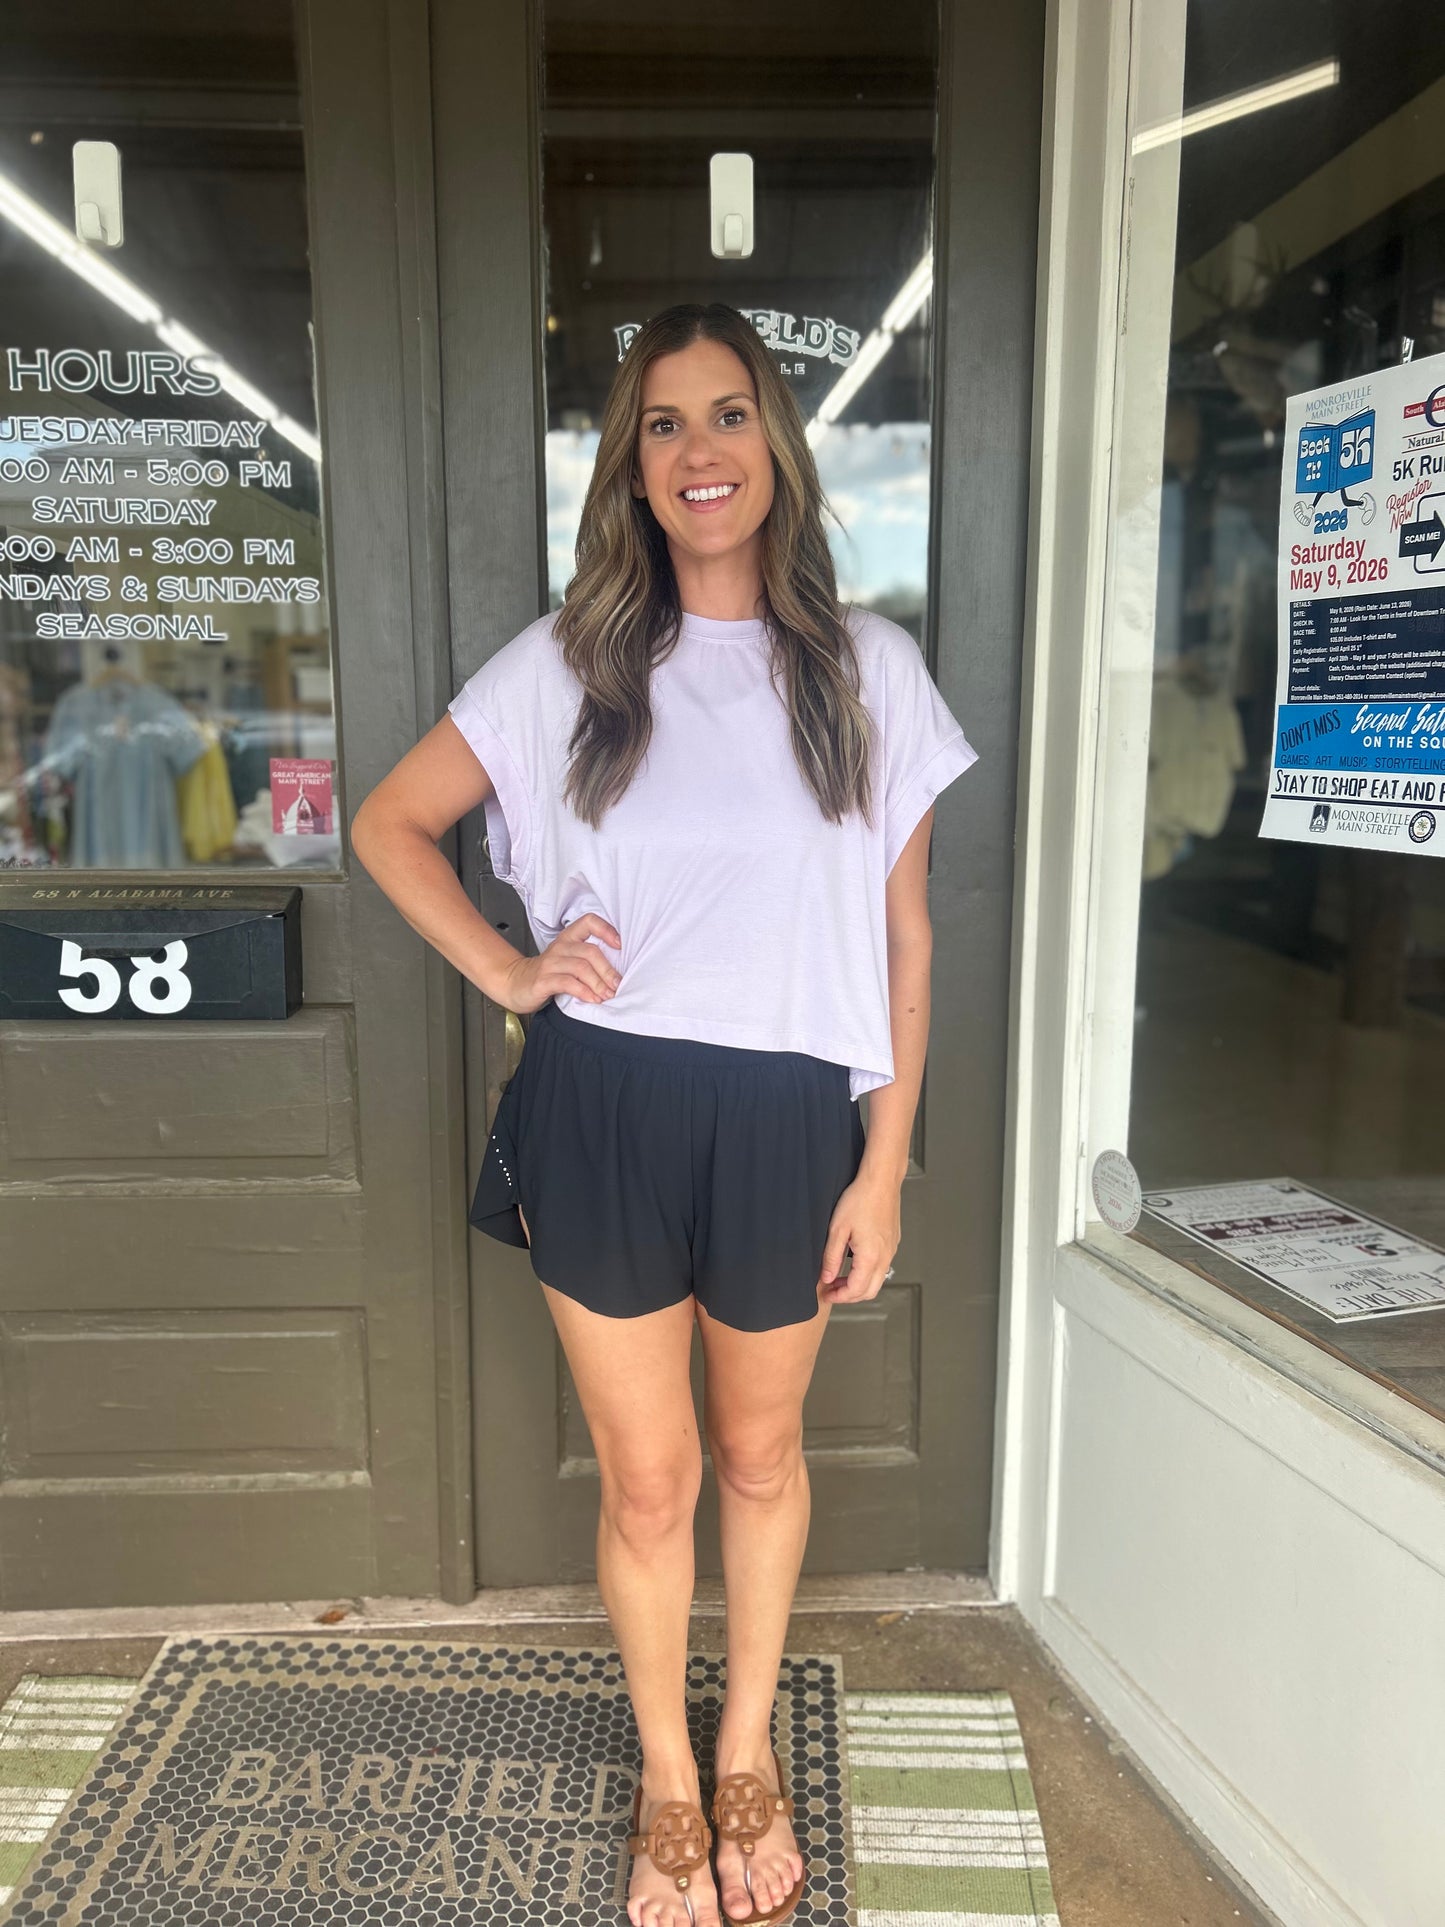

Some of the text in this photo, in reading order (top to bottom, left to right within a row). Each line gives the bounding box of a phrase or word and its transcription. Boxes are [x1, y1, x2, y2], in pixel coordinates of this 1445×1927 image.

[8, 348, 222, 396] HOURS
[1306, 384, 1372, 413] MONROEVILLE
[1311, 398, 1365, 420] MAIN STREET
[1405, 404, 1425, 416] South
[1300, 434, 1330, 459] Book
[1408, 431, 1445, 449] Natural
[61, 458, 114, 484] AM
[124, 468, 138, 479] -
[147, 459, 229, 486] 5:00
[240, 461, 291, 487] PM
[1393, 454, 1445, 481] 5K Ru
[1386, 478, 1432, 515] Register
[32, 497, 216, 525] SATURDAY
[1314, 508, 1348, 534] 2026
[1390, 501, 1414, 533] Now
[65, 537, 119, 563] AM
[129, 547, 143, 558] -
[152, 538, 234, 564] 3:00
[244, 539, 295, 564] PM
[1291, 536, 1366, 566] Saturday
[1404, 531, 1441, 544] SCAN ME!
[1290, 557, 1388, 593] May 9, 2026
[121, 576, 147, 602] &
[157, 577, 320, 603] SUNDAYS
[36, 613, 228, 640] SEASONAL
[1293, 610, 1306, 618] DATE:
[1280, 709, 1341, 751] DON'T MISS
[1351, 704, 1412, 734] Second
[1363, 736, 1382, 748] ON
[1388, 736, 1413, 748] THE
[1281, 754, 1309, 766] GAMES
[1315, 755, 1333, 766] ART
[1339, 755, 1368, 768] MUSIC
[296, 771, 331, 779] AMERICAN
[1312, 776, 1328, 795] TO
[1331, 776, 1367, 797] SHOP
[1371, 779, 1399, 799] EAT
[1402, 781, 1436, 801] AND
[1331, 809, 1411, 826] MONROEVILLE
[1336, 821, 1400, 836] MAIN STREET
[32, 889, 234, 899] 58 N ALABAMA AVE
[57, 939, 192, 1014] 58
[205, 1749, 642, 1823] BARFIELD
[126, 1822, 630, 1906] MERCANTI
